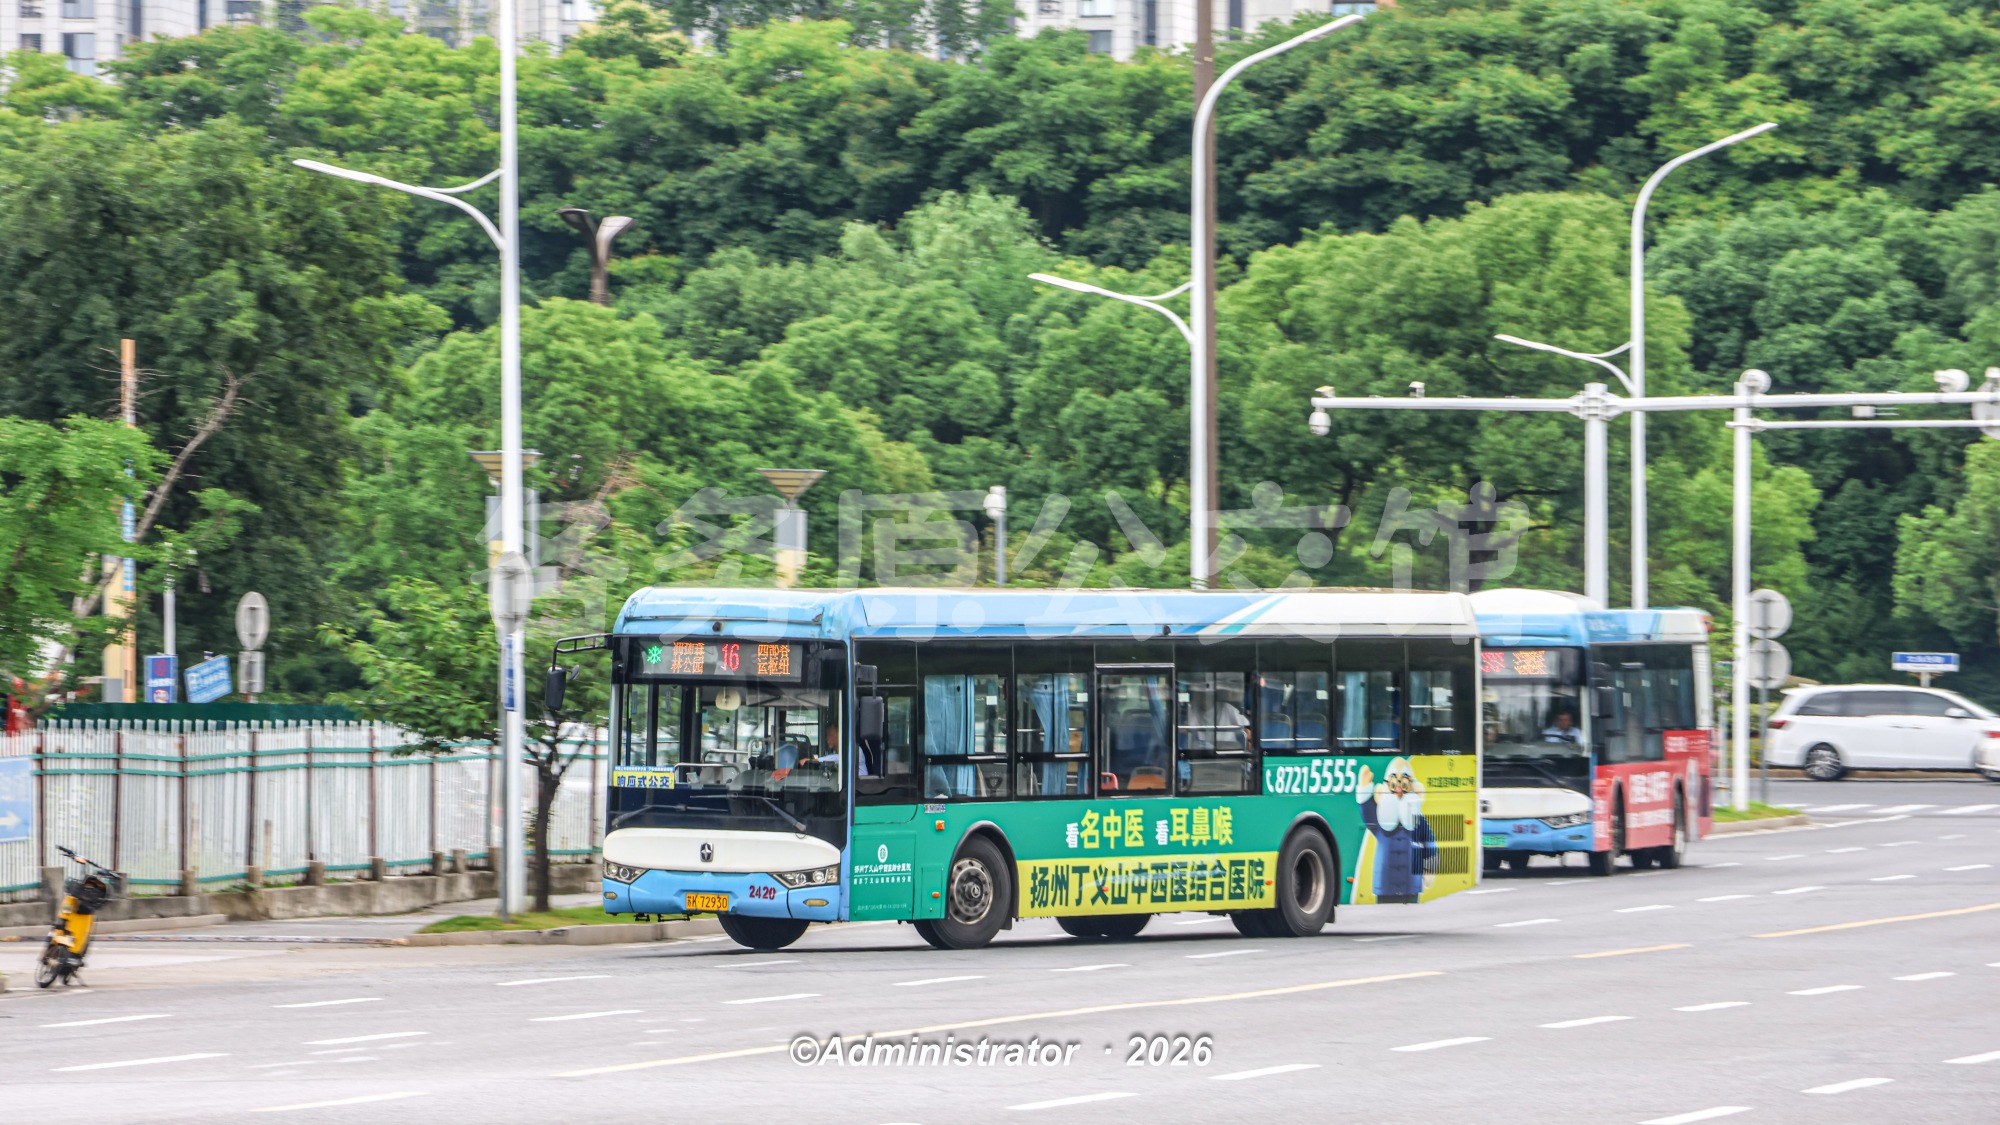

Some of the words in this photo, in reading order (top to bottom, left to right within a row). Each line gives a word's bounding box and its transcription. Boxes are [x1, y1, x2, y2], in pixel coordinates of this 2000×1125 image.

[722, 643, 740, 671] 16
[617, 774, 670, 788] 响应式公交
[1274, 759, 1357, 794] 87215555
[1065, 808, 1144, 849] 看名中医
[1155, 806, 1233, 847] 看耳鼻喉
[748, 885, 777, 900] 2420
[1030, 858, 1265, 909] 扬州丁义山中西医结合医院
